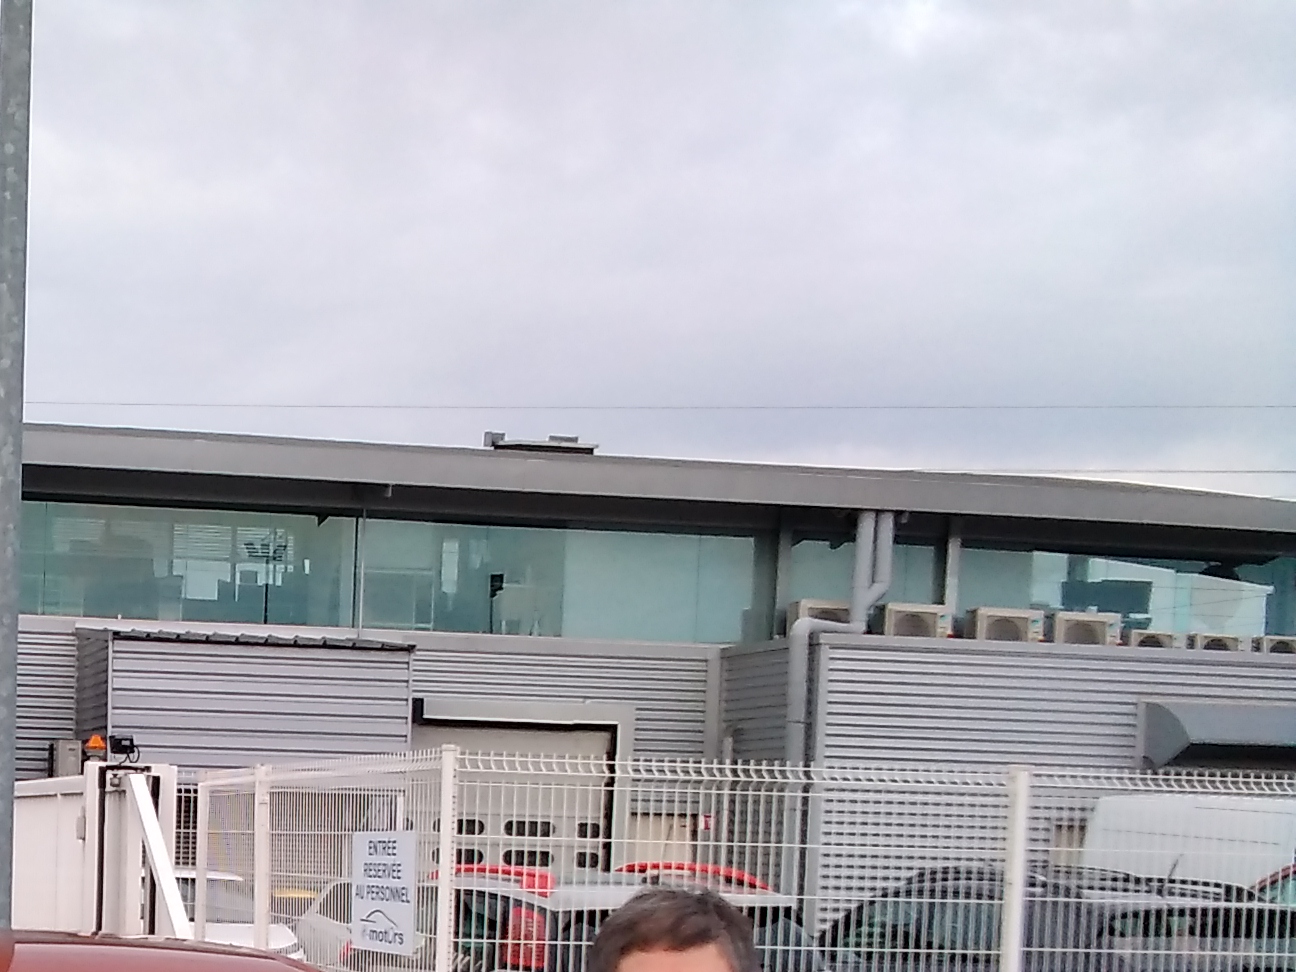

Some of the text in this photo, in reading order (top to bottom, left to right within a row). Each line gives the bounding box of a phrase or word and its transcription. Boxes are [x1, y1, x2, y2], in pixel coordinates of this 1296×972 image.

[368, 837, 397, 856] ENTRÉE
[355, 884, 411, 904] AU PERSONNEL
